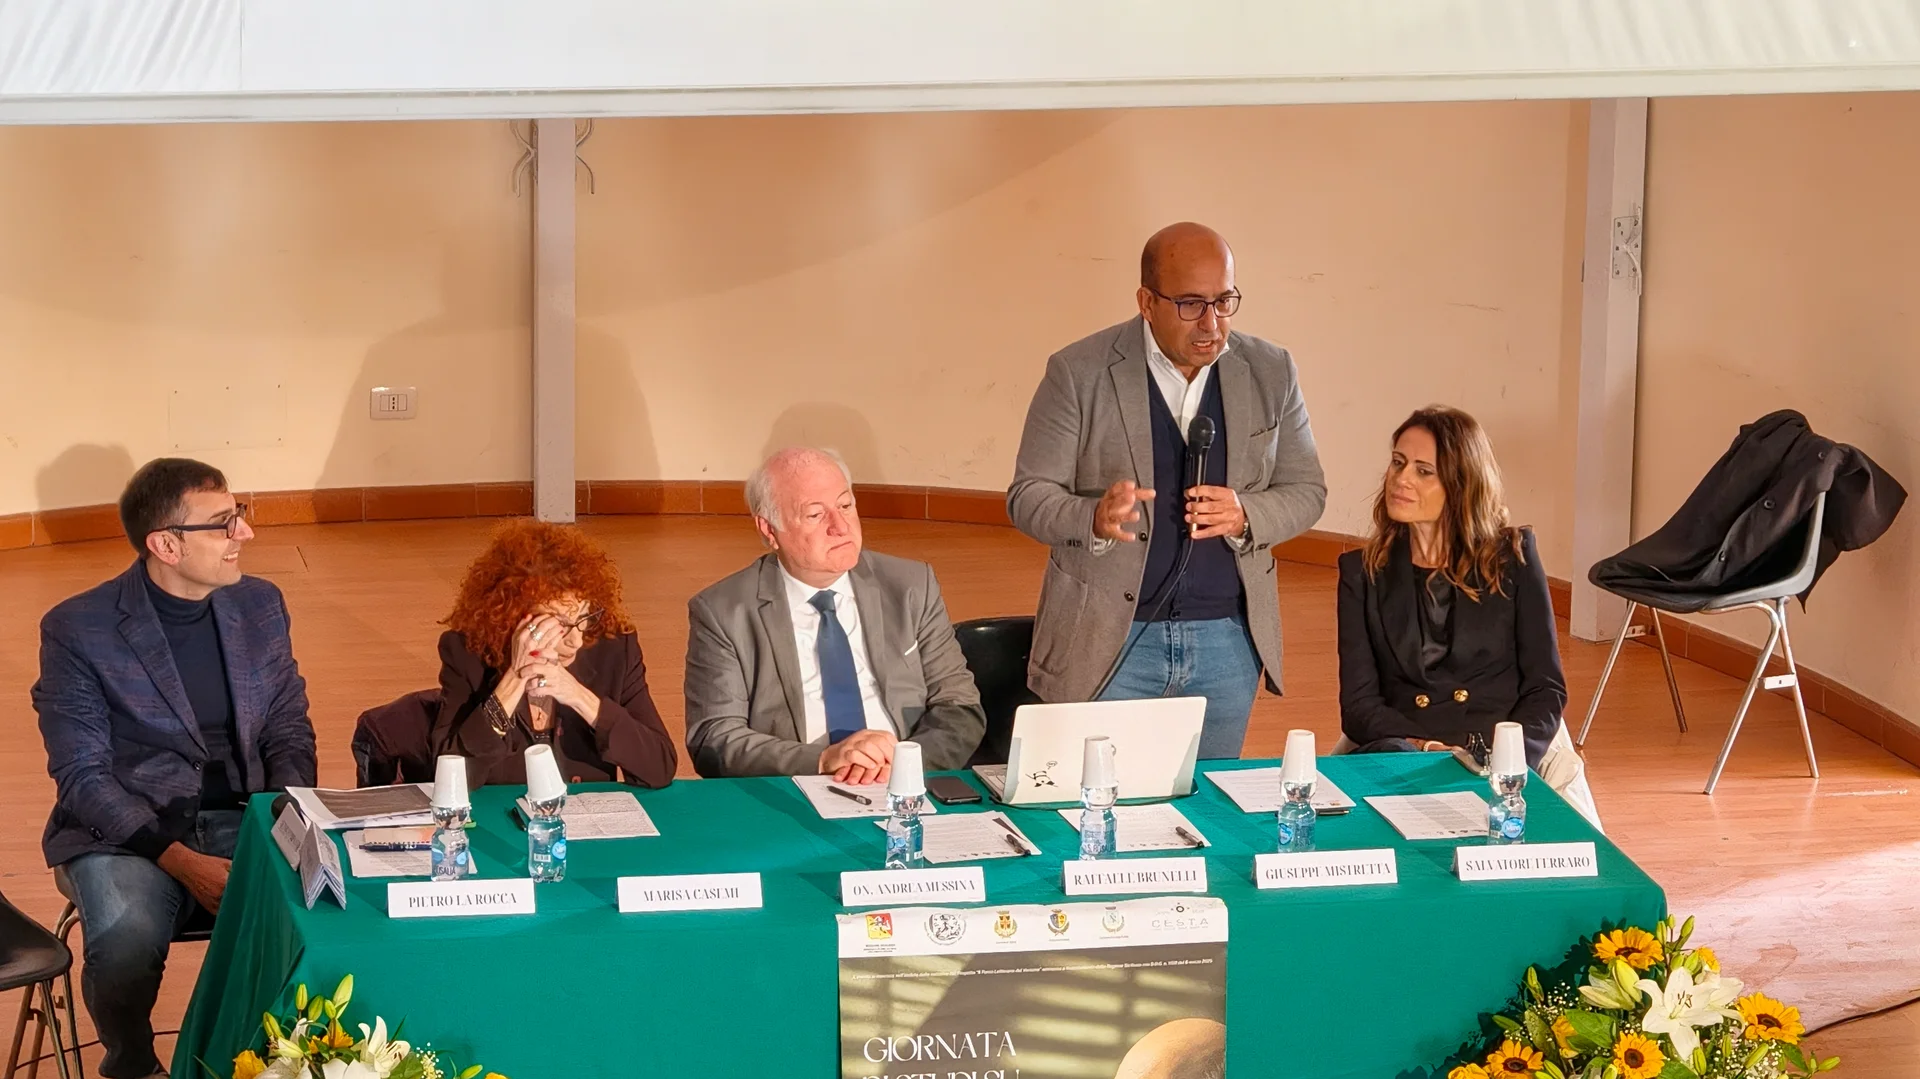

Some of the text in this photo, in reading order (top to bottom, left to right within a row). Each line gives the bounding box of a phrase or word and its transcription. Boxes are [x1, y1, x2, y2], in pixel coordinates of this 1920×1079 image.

[1265, 862, 1391, 880] GIUSEPPE MISTRETTA
[1465, 856, 1590, 872] SALVATORE FERRARO
[1074, 870, 1197, 886] RAFFAELE BRUNELLI
[643, 888, 691, 902] MARISA
[878, 881, 923, 895] ANDREA
[925, 879, 976, 893] MESSINA
[408, 892, 518, 908] PIETRO LA ROCCA
[863, 1031, 1017, 1063] GIORNATA
